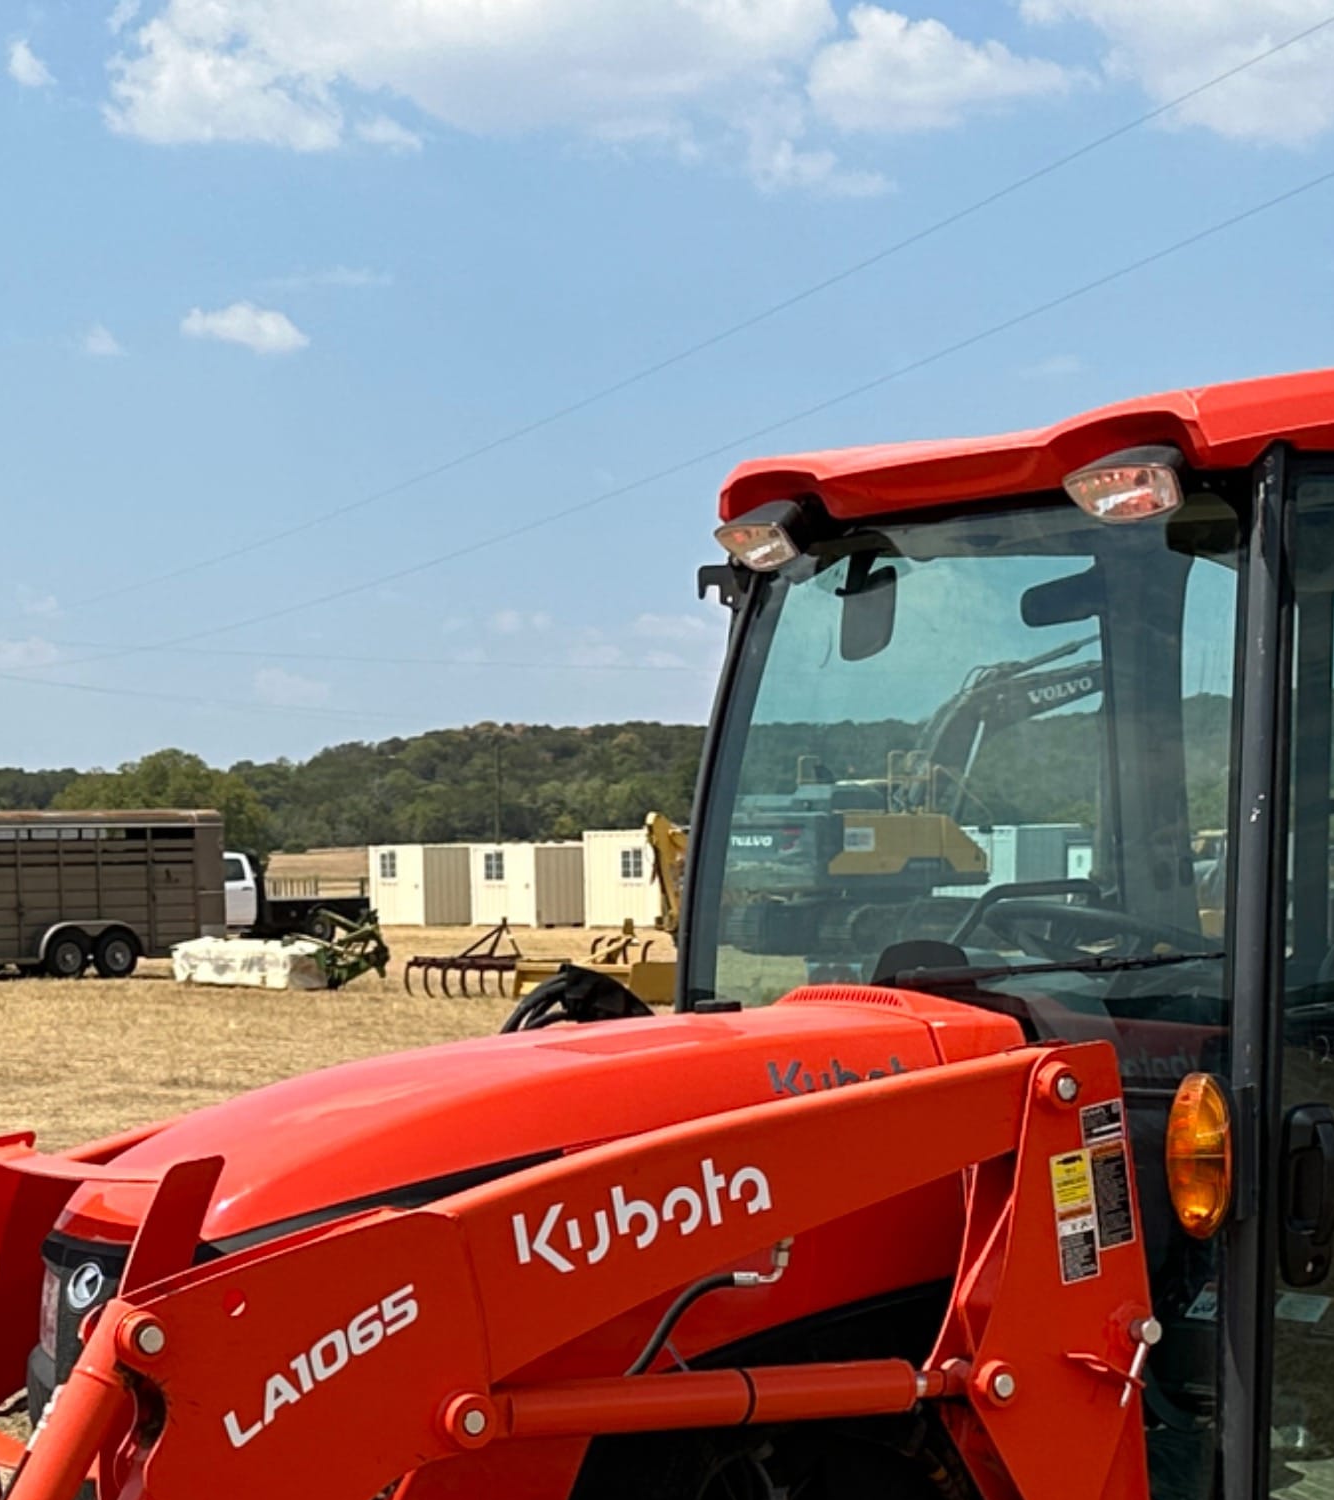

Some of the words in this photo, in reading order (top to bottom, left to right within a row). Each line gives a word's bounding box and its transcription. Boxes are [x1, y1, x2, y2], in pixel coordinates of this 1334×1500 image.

[1027, 676, 1093, 704] VOLVO
[766, 1056, 909, 1096] Kubt
[512, 1157, 772, 1273] Kubota
[223, 1282, 419, 1448] LA1065
